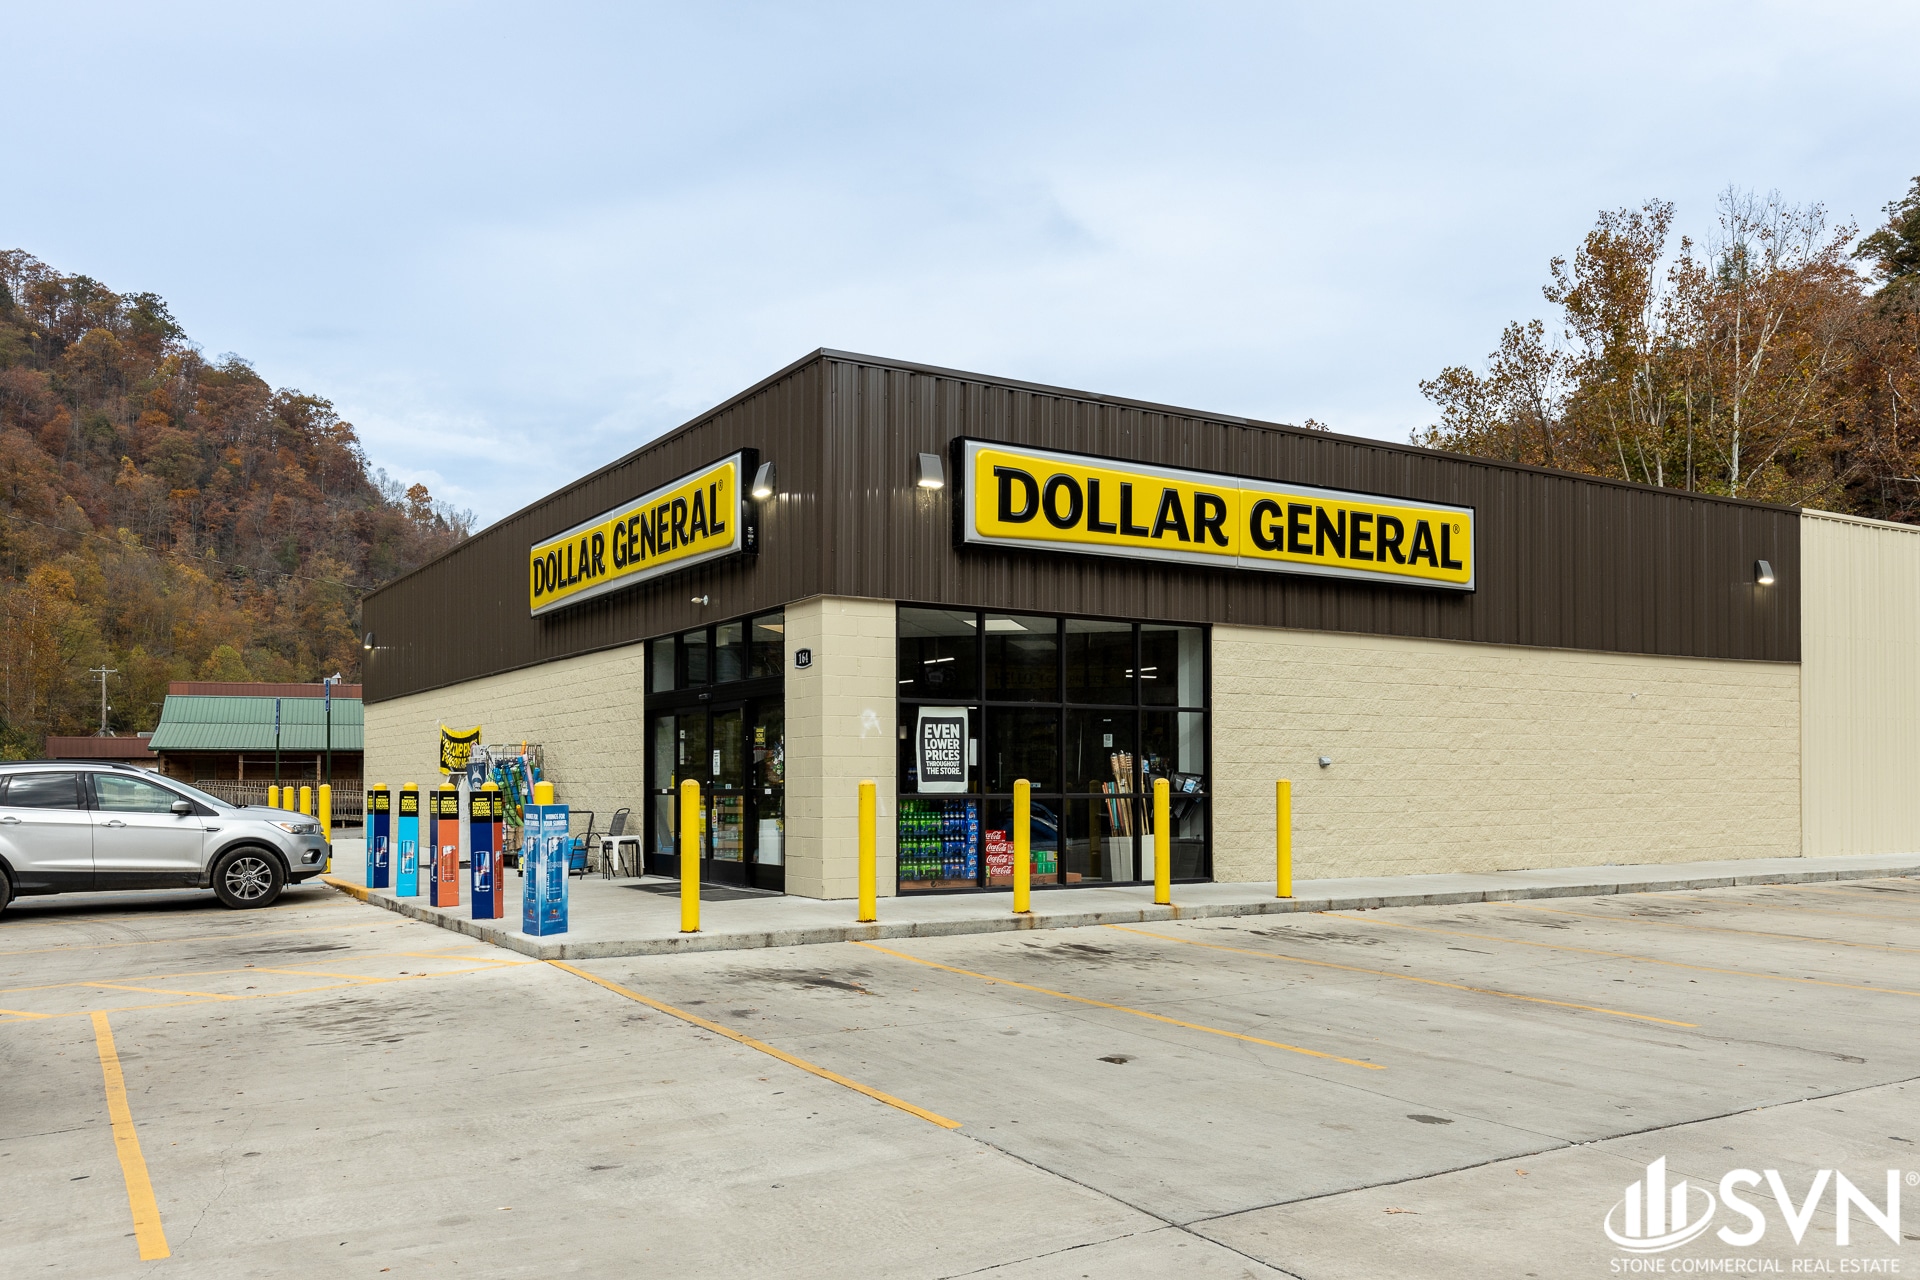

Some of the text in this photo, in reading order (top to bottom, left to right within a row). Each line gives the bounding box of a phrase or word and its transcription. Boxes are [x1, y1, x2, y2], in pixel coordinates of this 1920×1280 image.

[993, 465, 1230, 547] DOLLAR
[533, 530, 606, 598] DOLLAR
[798, 652, 809, 664] 164
[924, 723, 960, 739] EVEN
[924, 738, 960, 750] LOWER
[925, 749, 960, 761] PRICES
[926, 767, 962, 775] THE STORE.
